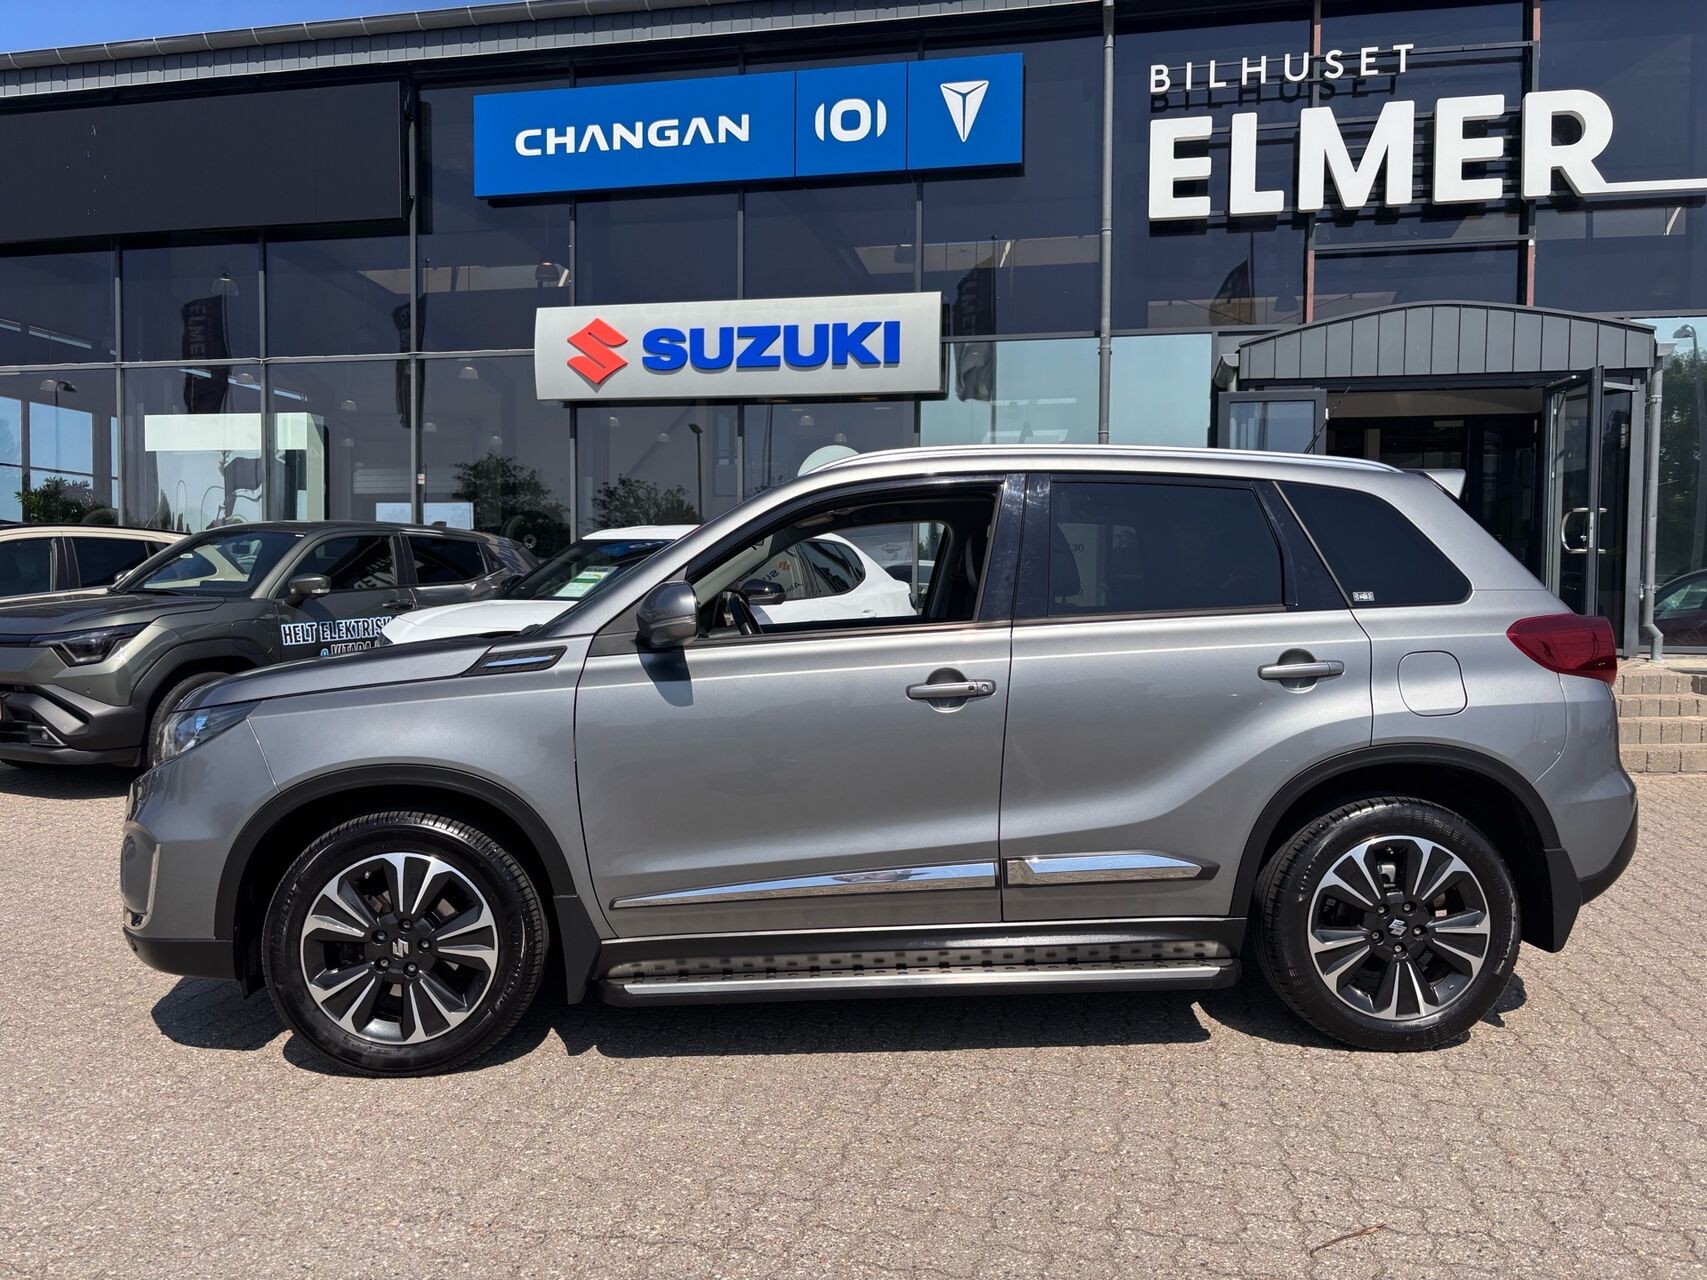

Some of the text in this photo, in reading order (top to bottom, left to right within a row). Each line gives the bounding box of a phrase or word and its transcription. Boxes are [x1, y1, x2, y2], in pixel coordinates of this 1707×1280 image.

[1149, 43, 1415, 94] BILHUSET
[514, 113, 750, 157] CHANGAN
[1148, 89, 1614, 221] ELMER
[188, 304, 207, 360] ELME
[641, 320, 901, 371] SUZUKI
[281, 622, 317, 645] HELT
